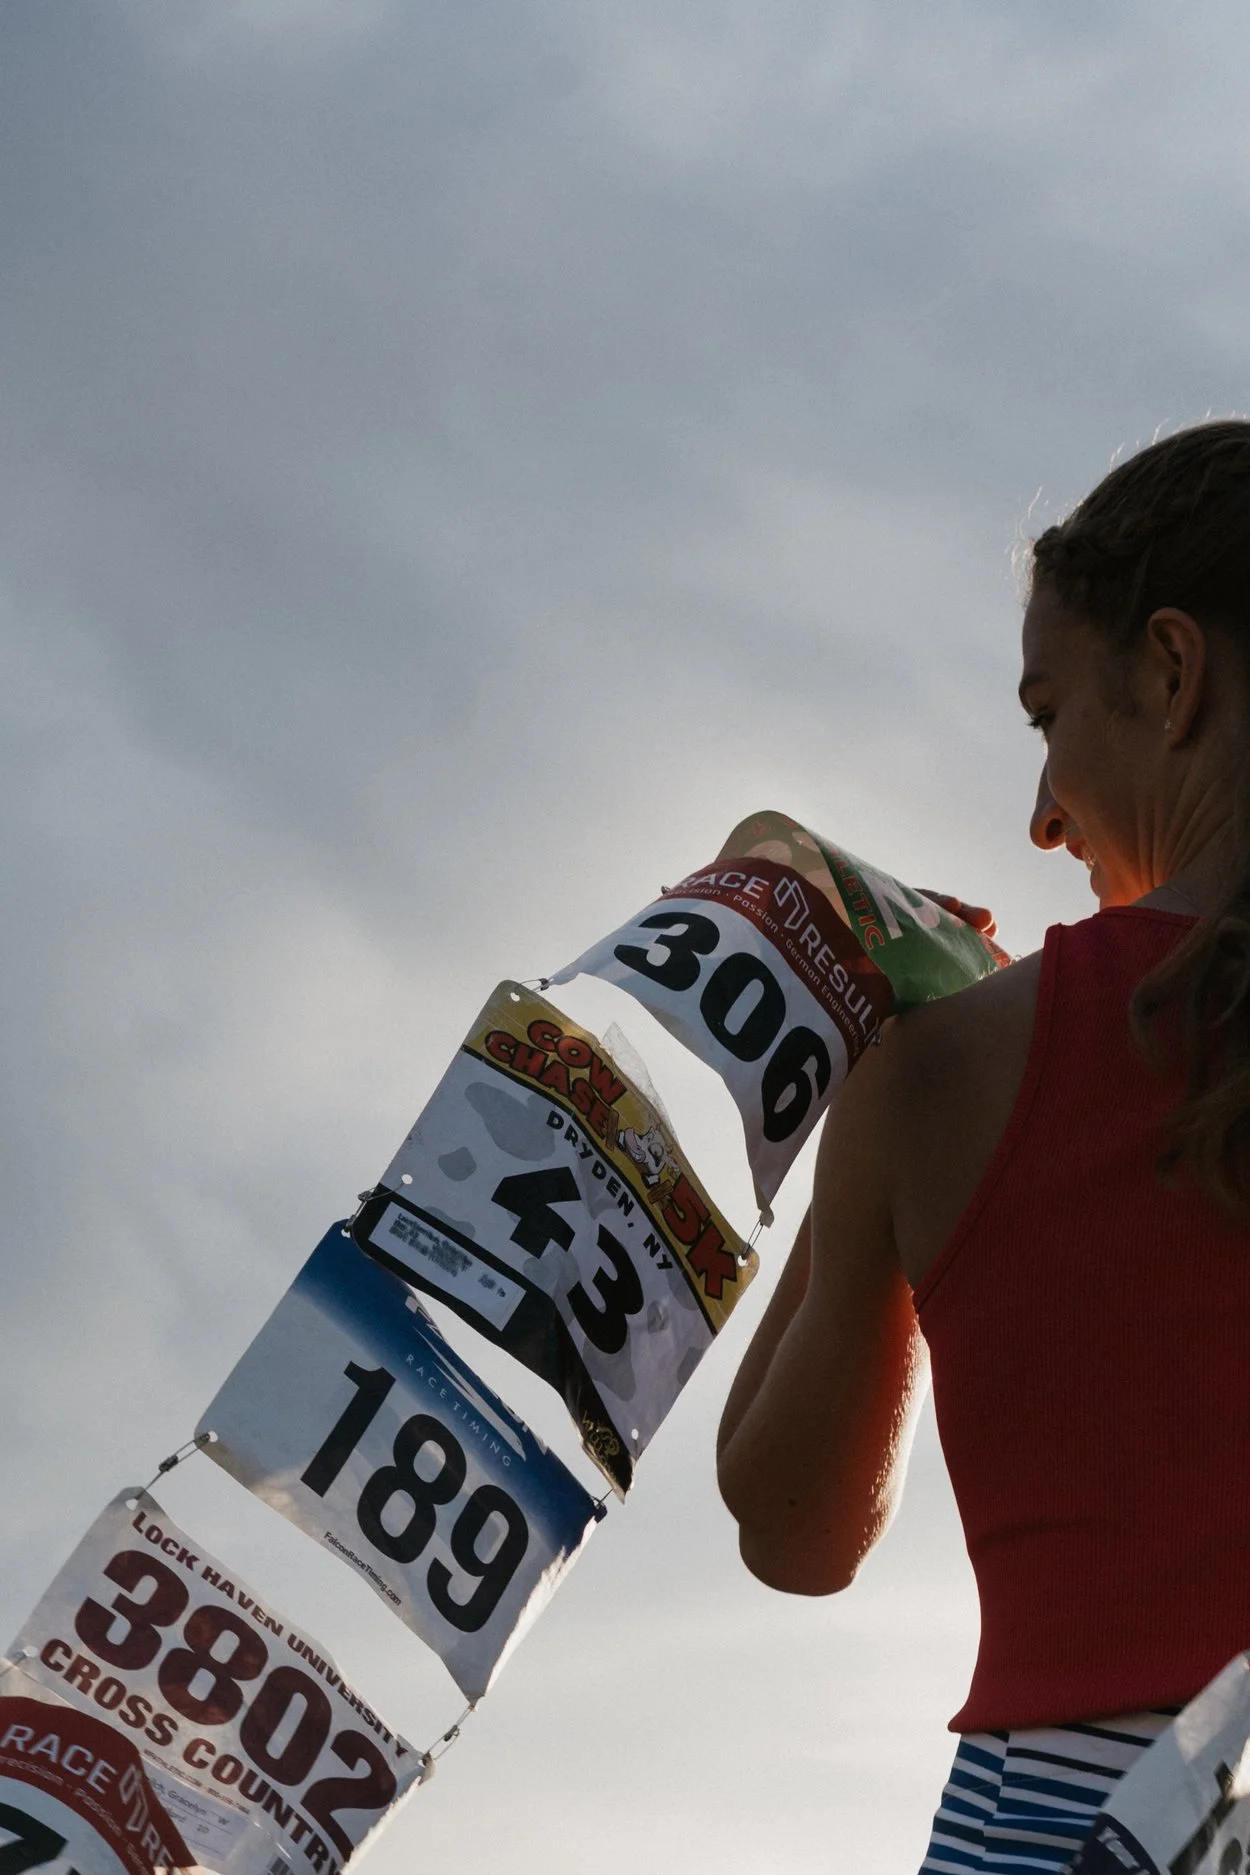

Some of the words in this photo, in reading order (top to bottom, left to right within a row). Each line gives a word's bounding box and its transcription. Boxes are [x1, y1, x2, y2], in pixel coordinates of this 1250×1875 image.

[681, 872, 770, 901] RACE
[800, 924, 880, 1043] RESULT
[733, 892, 779, 934] Passion
[782, 937, 823, 985] German
[484, 1030, 618, 1142] CHASE
[526, 1020, 628, 1104] COW
[614, 911, 831, 1143] 306
[545, 1109, 637, 1230] DRYDEN,
[643, 1231, 674, 1273] NY
[660, 1176, 738, 1301] 5K
[491, 1166, 644, 1354] 43
[404, 1352, 450, 1400] RACE
[450, 1399, 514, 1468] TIMING
[300, 1360, 530, 1634] 189
[323, 1530, 403, 1606] FalconRaceTiming.com
[39, 1637, 180, 1748] CROSS
[132, 1510, 198, 1571] LOCK
[202, 1564, 285, 1638] HAVEN
[287, 1631, 409, 1759] UNIVERSITY
[1, 1724, 118, 1797] RACE
[74, 1549, 399, 1864] 3802
